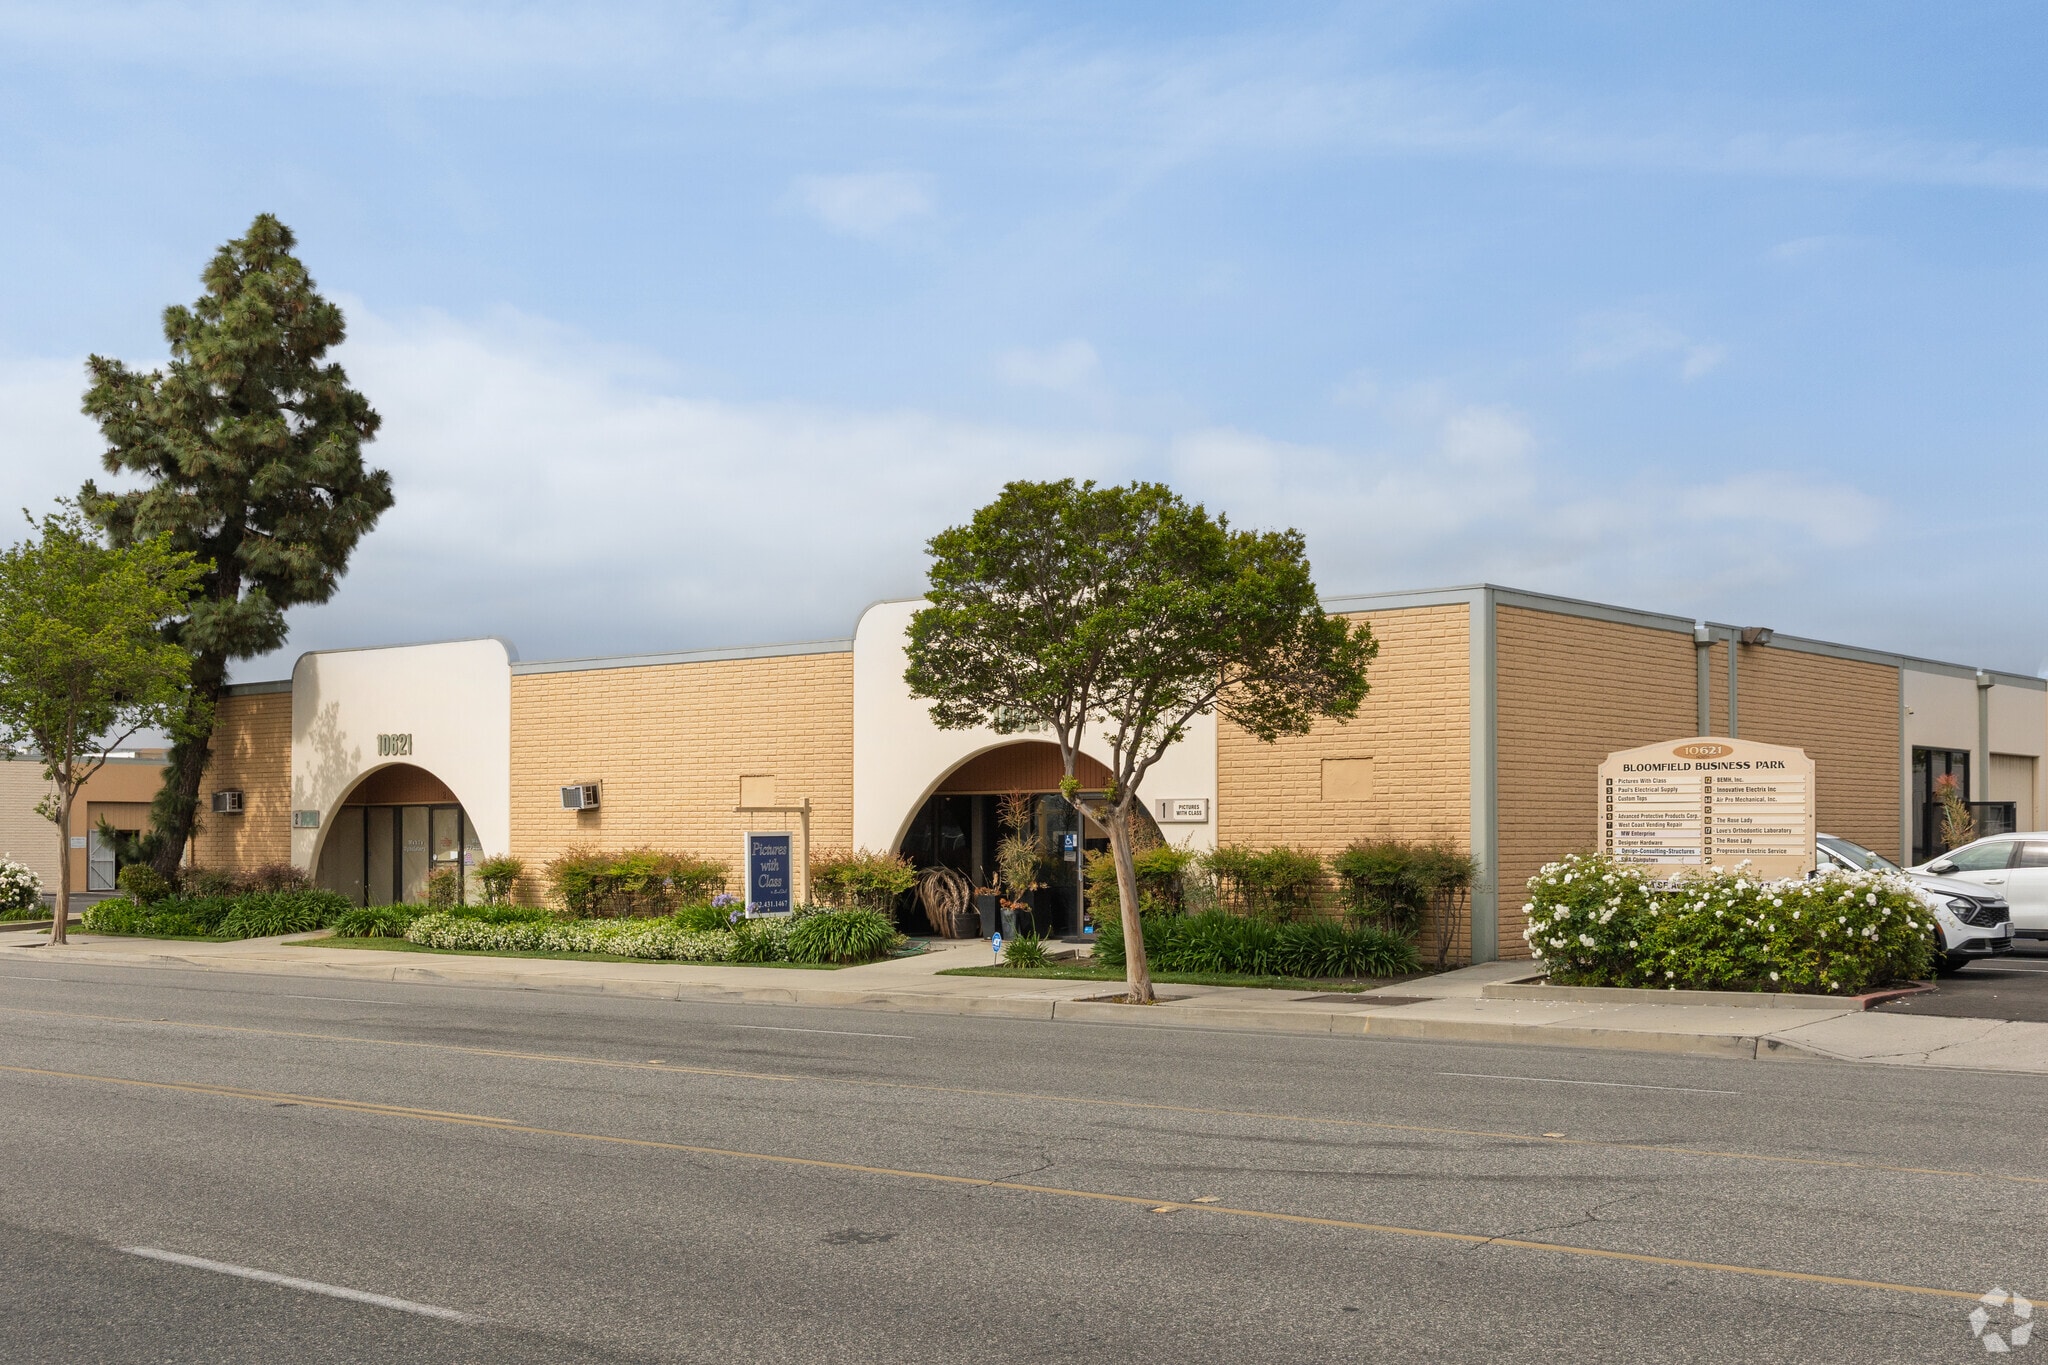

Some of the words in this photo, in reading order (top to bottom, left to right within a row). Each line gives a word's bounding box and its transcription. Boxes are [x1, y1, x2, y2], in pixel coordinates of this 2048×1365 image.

[377, 733, 412, 756] 10621
[1684, 746, 1722, 755] 10621
[1623, 763, 1691, 772] BLOOMFIELD
[1695, 761, 1751, 770] BUSINESS
[1756, 760, 1785, 769] PARK
[1162, 802, 1166, 818] 1
[752, 842, 788, 856] Pictures
[761, 858, 779, 871] with
[758, 874, 782, 888] Class
[752, 900, 788, 908] 2.431.1467
